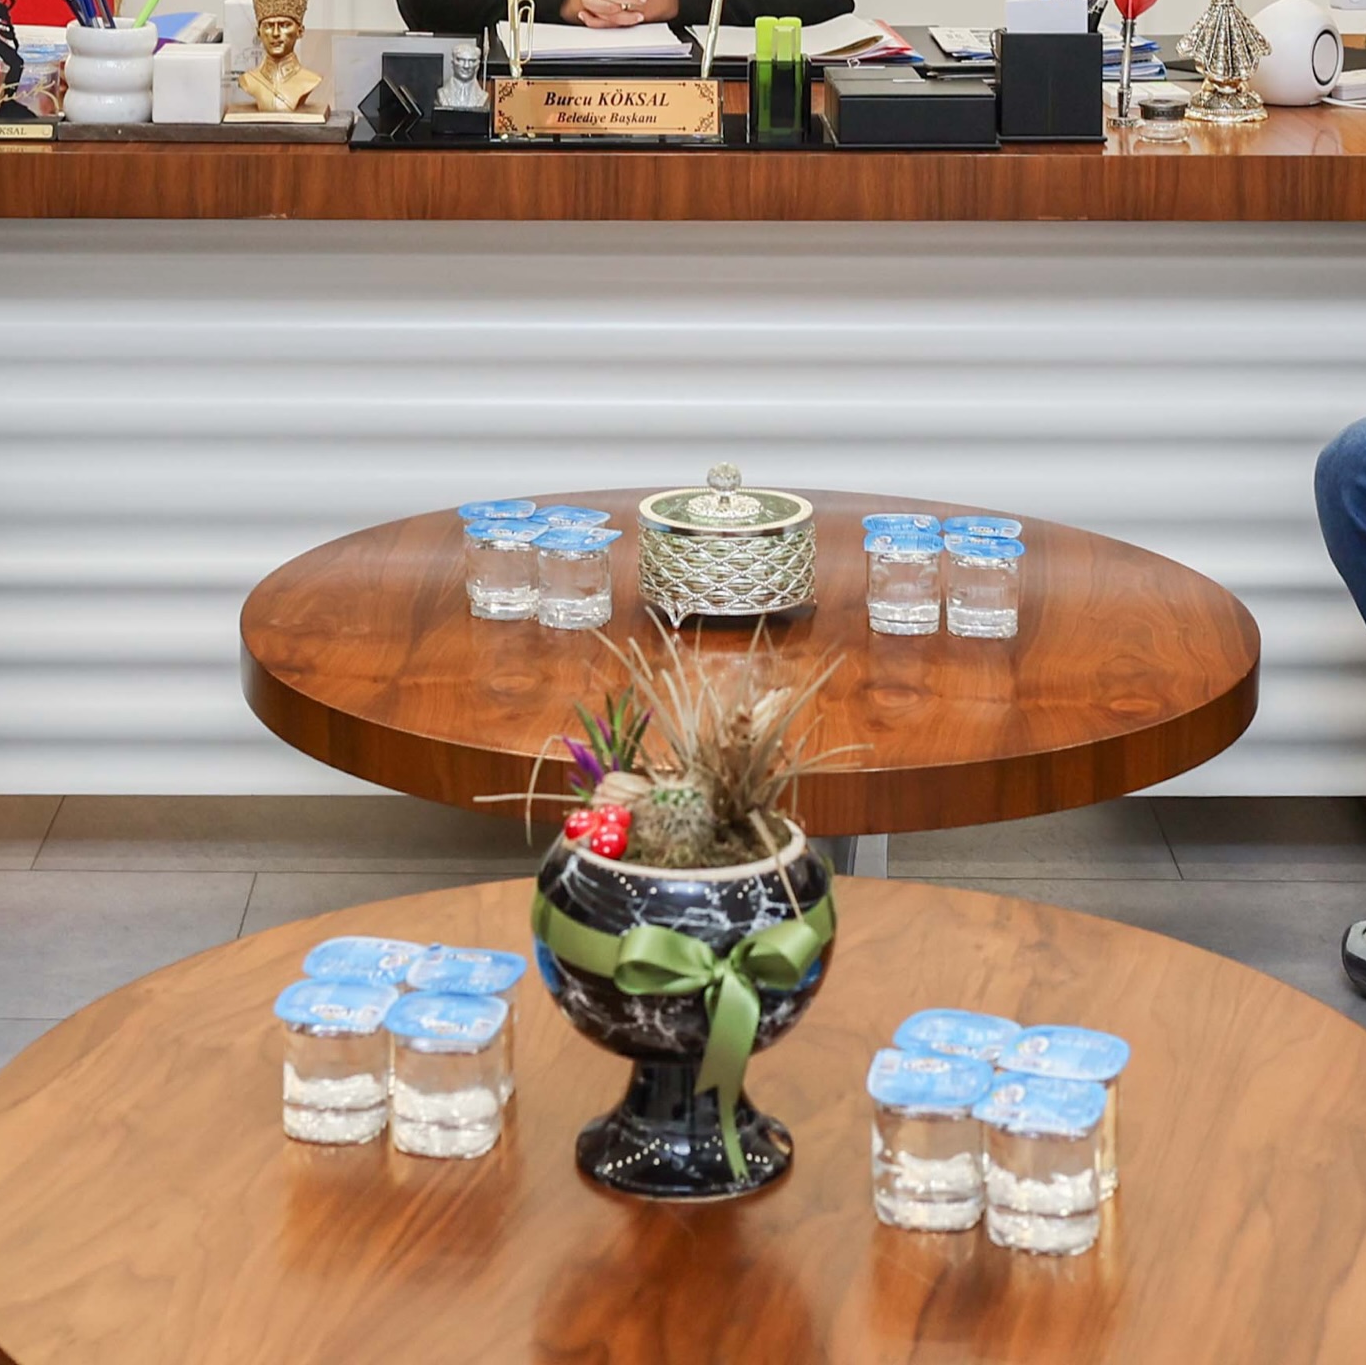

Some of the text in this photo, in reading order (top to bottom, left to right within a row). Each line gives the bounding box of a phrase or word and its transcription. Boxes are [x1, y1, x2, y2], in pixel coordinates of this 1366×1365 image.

[544, 89, 670, 107] Burcu KÖKSAL
[557, 112, 657, 125] Belediye Başkanı
